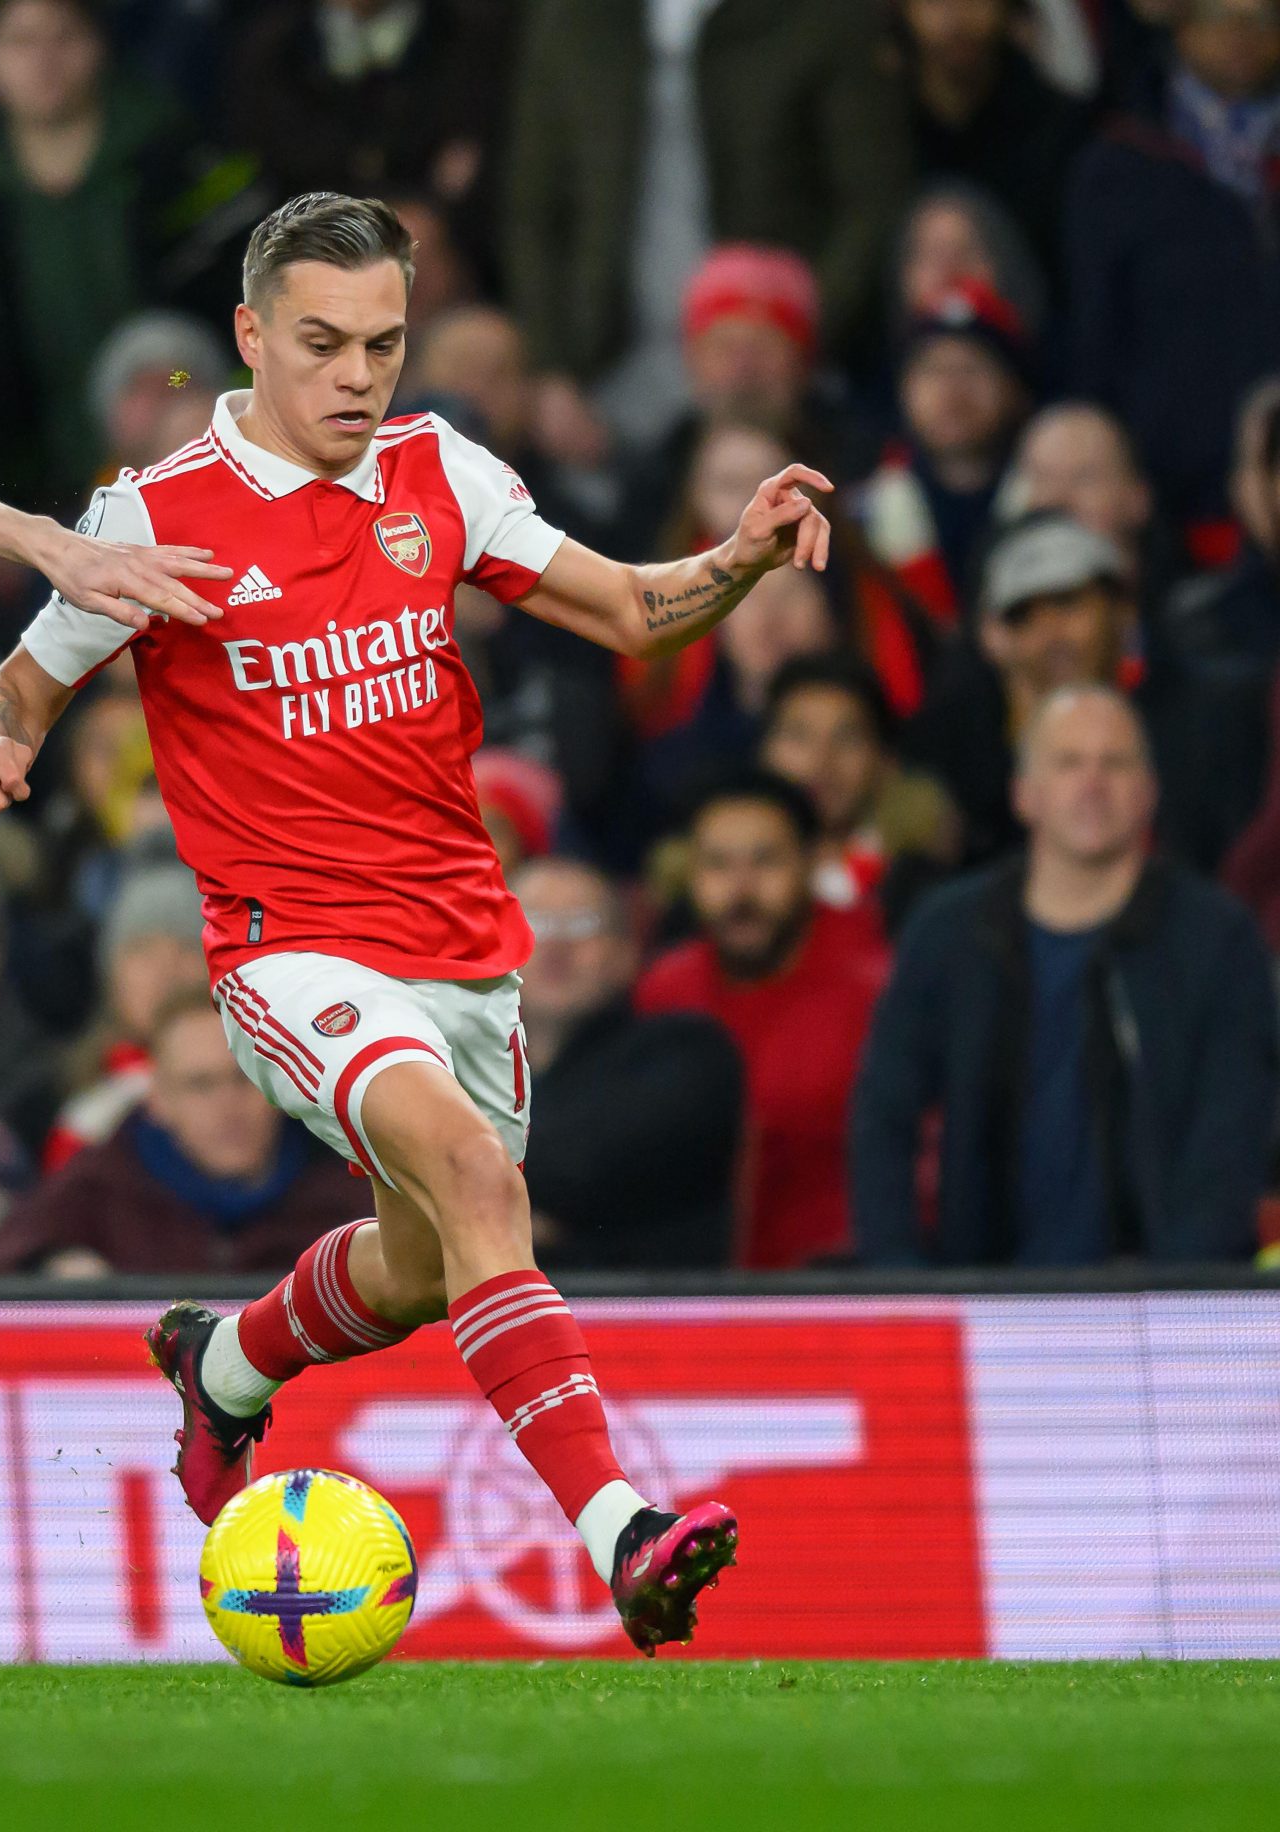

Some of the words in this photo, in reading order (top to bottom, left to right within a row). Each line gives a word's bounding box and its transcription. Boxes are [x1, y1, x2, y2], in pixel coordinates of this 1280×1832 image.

[382, 521, 419, 538] Arsenal
[227, 586, 283, 606] adidas
[222, 605, 449, 691] Emirates
[282, 688, 331, 740] FLY
[344, 657, 439, 730] BETTER
[506, 1027, 528, 1114] 1
